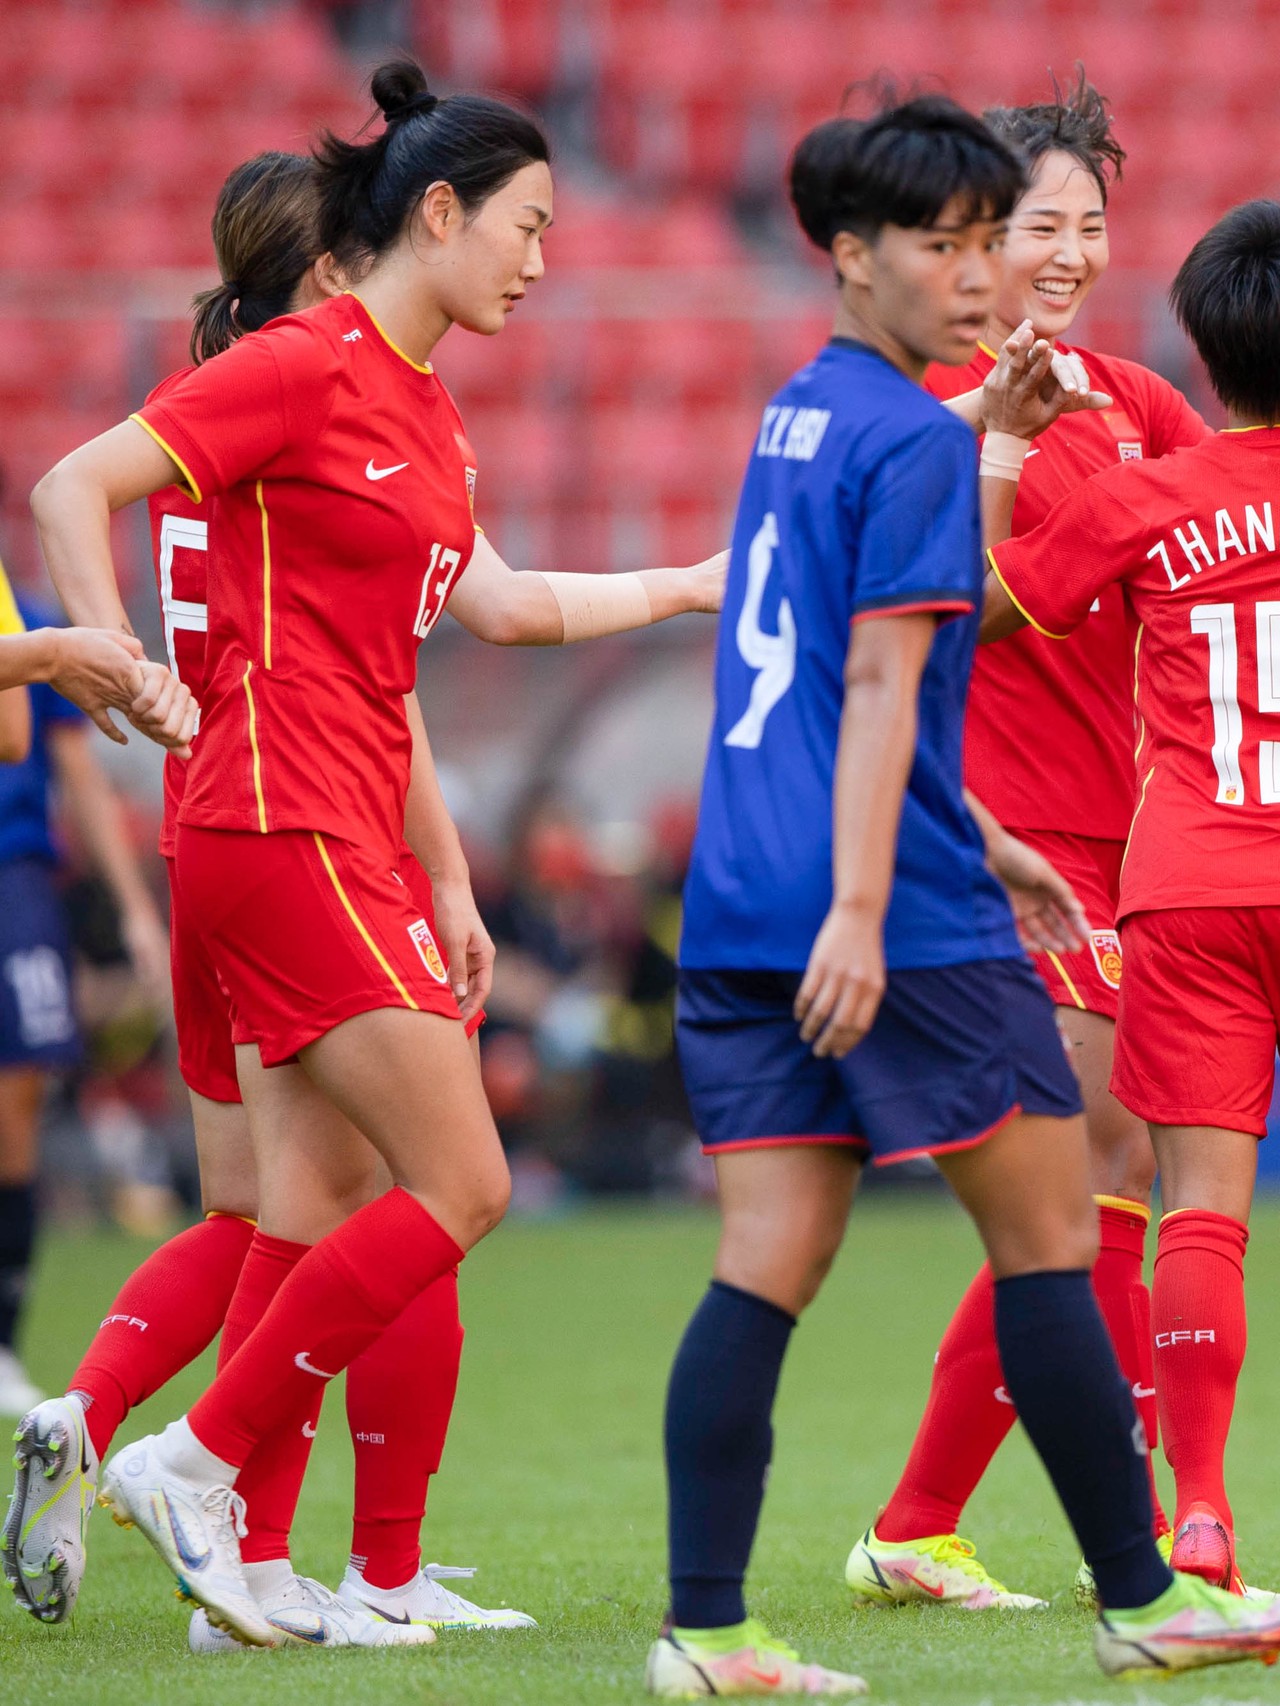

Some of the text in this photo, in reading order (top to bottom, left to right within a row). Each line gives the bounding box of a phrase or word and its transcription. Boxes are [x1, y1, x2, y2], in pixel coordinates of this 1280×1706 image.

[412, 542, 461, 639] 13
[100, 1314, 148, 1332] CFA
[1155, 1329, 1216, 1349] CFA
